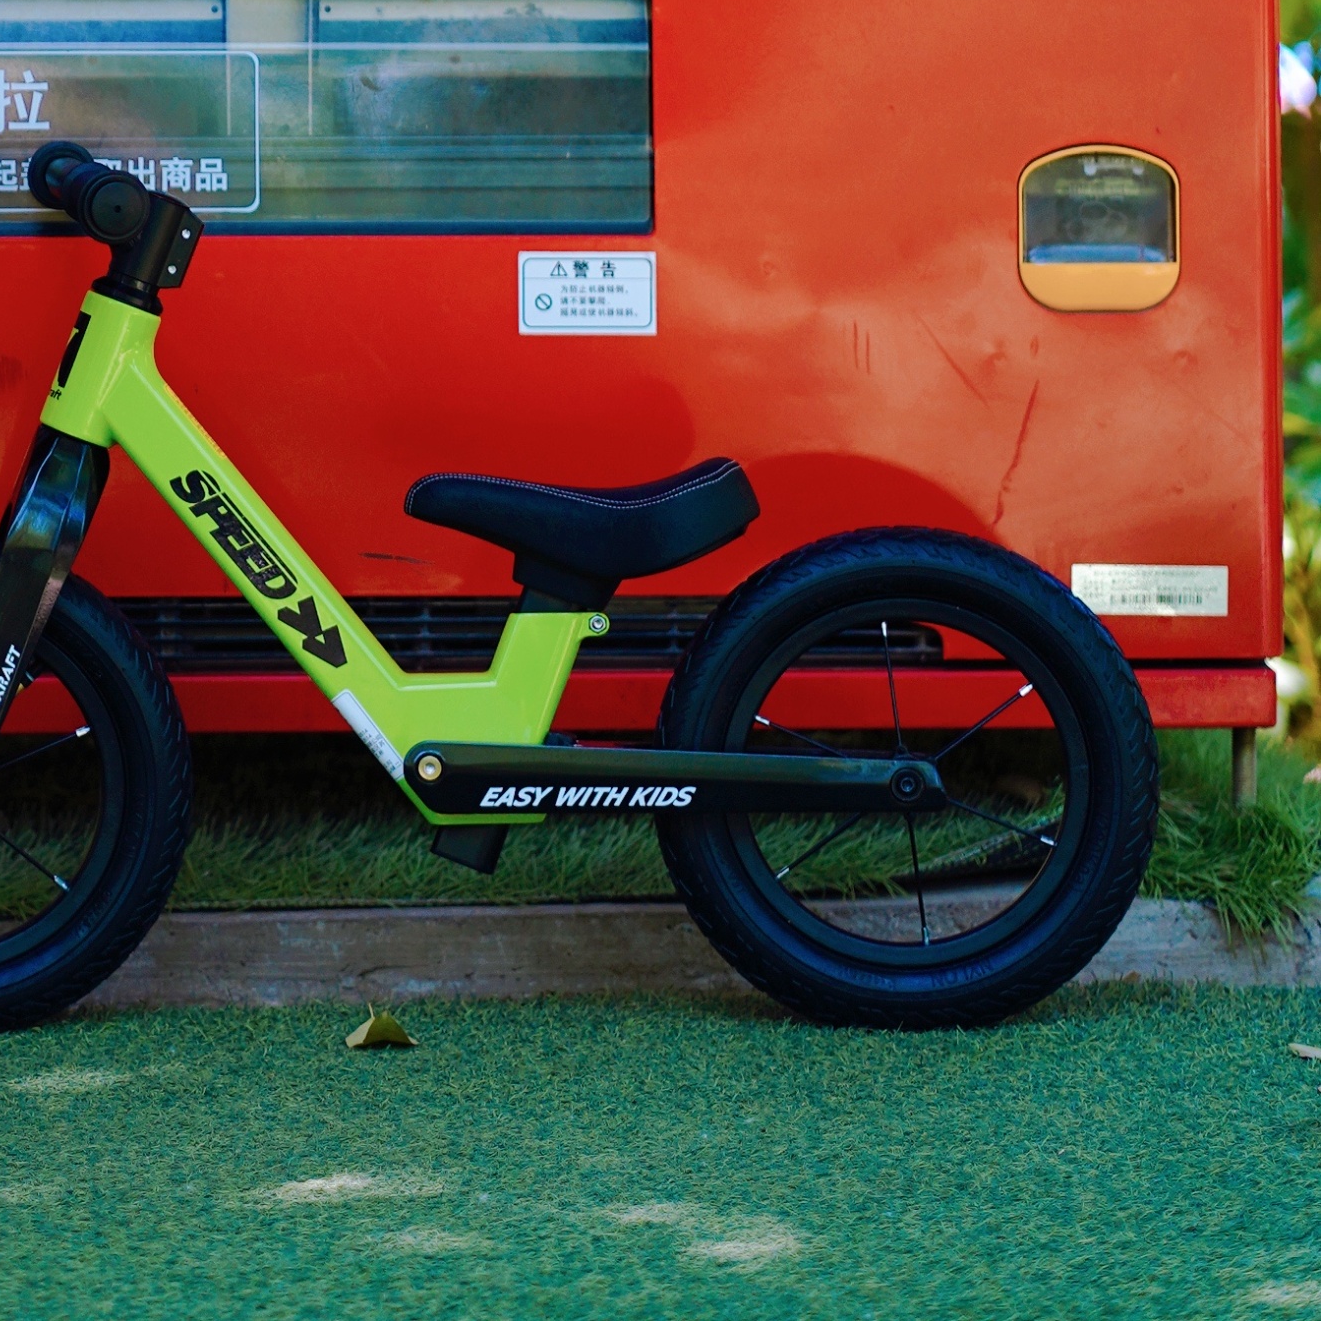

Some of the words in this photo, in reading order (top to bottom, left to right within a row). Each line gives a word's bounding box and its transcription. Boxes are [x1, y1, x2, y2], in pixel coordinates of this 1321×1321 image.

[572, 259, 617, 278] 警告
[169, 469, 299, 600] SPEED
[479, 786, 554, 808] EASY
[554, 786, 629, 808] WITH
[628, 786, 697, 808] KIDS
